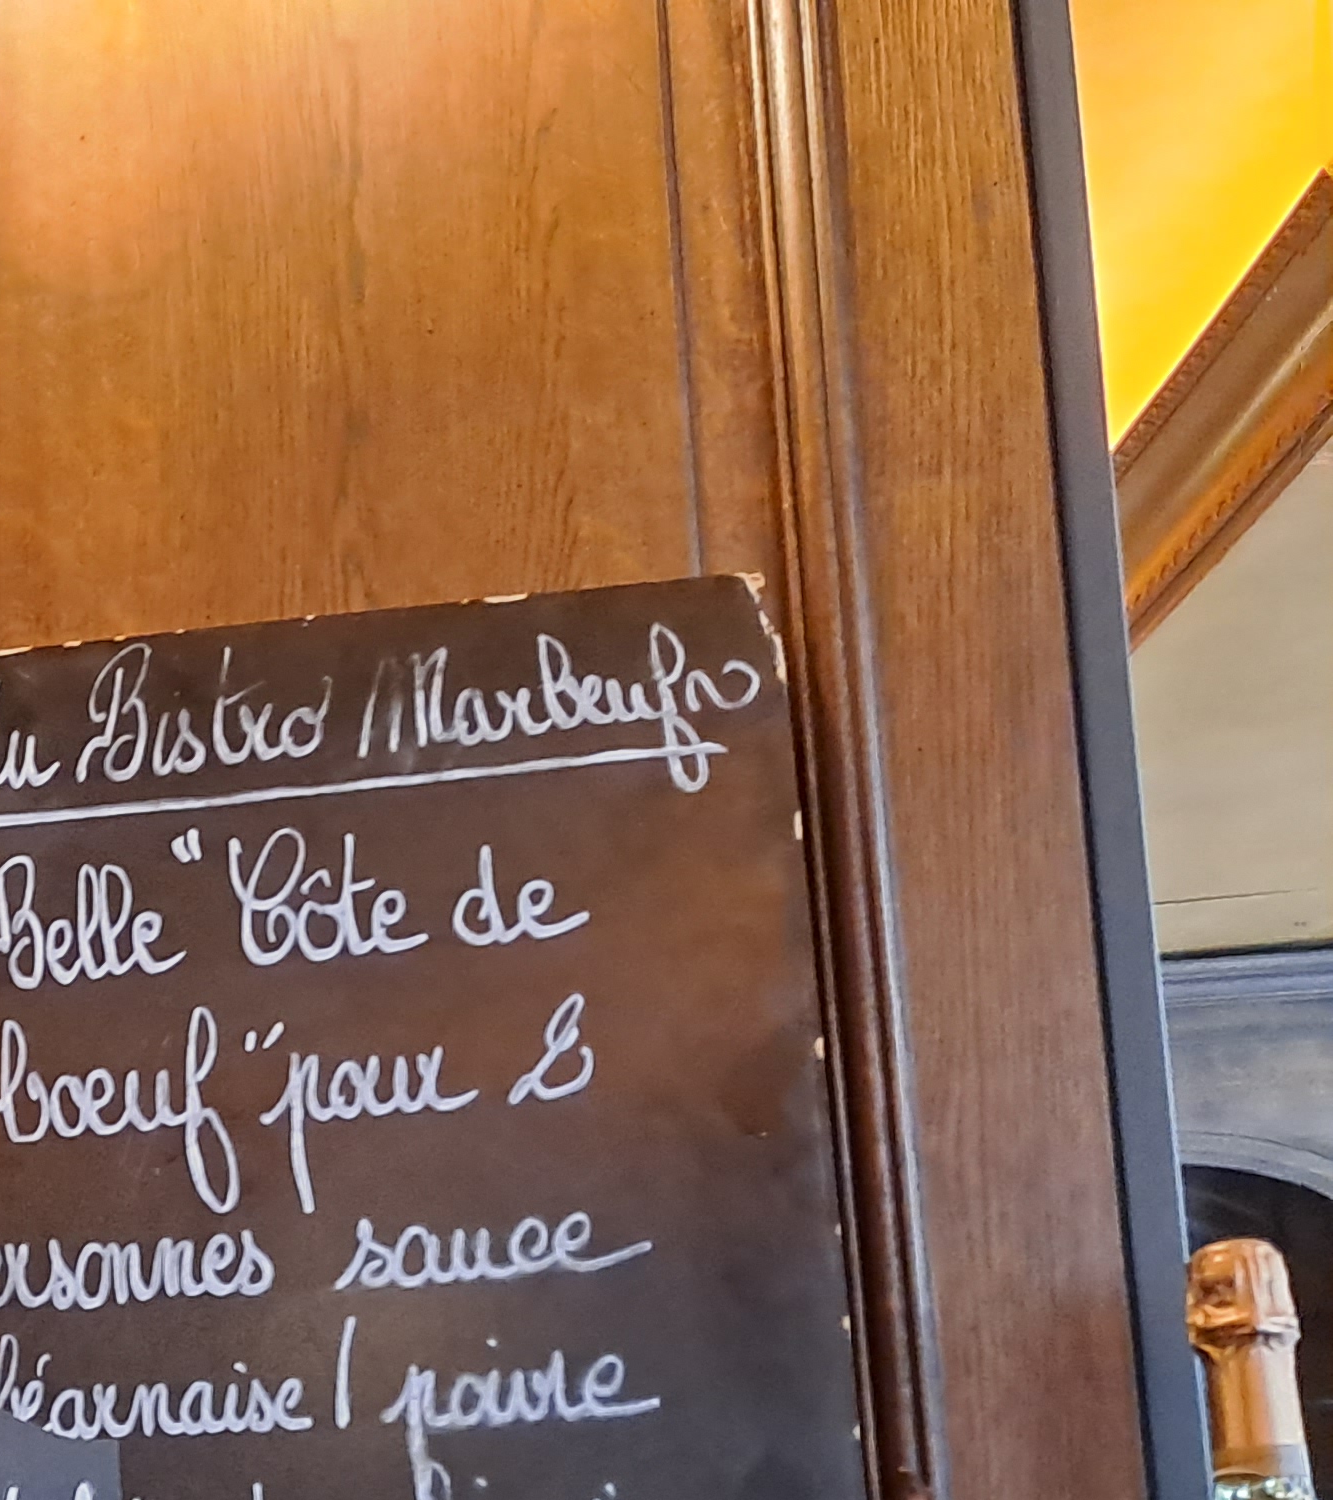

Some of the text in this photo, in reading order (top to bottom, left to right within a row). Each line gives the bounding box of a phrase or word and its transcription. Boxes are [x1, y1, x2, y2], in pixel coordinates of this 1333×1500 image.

[76, 642, 334, 784] Bistro
[355, 622, 709, 794] Marbeuf
[452, 844, 591, 946] de
[259, 1046, 479, 1214] pour
[334, 1211, 654, 1291] sauce
